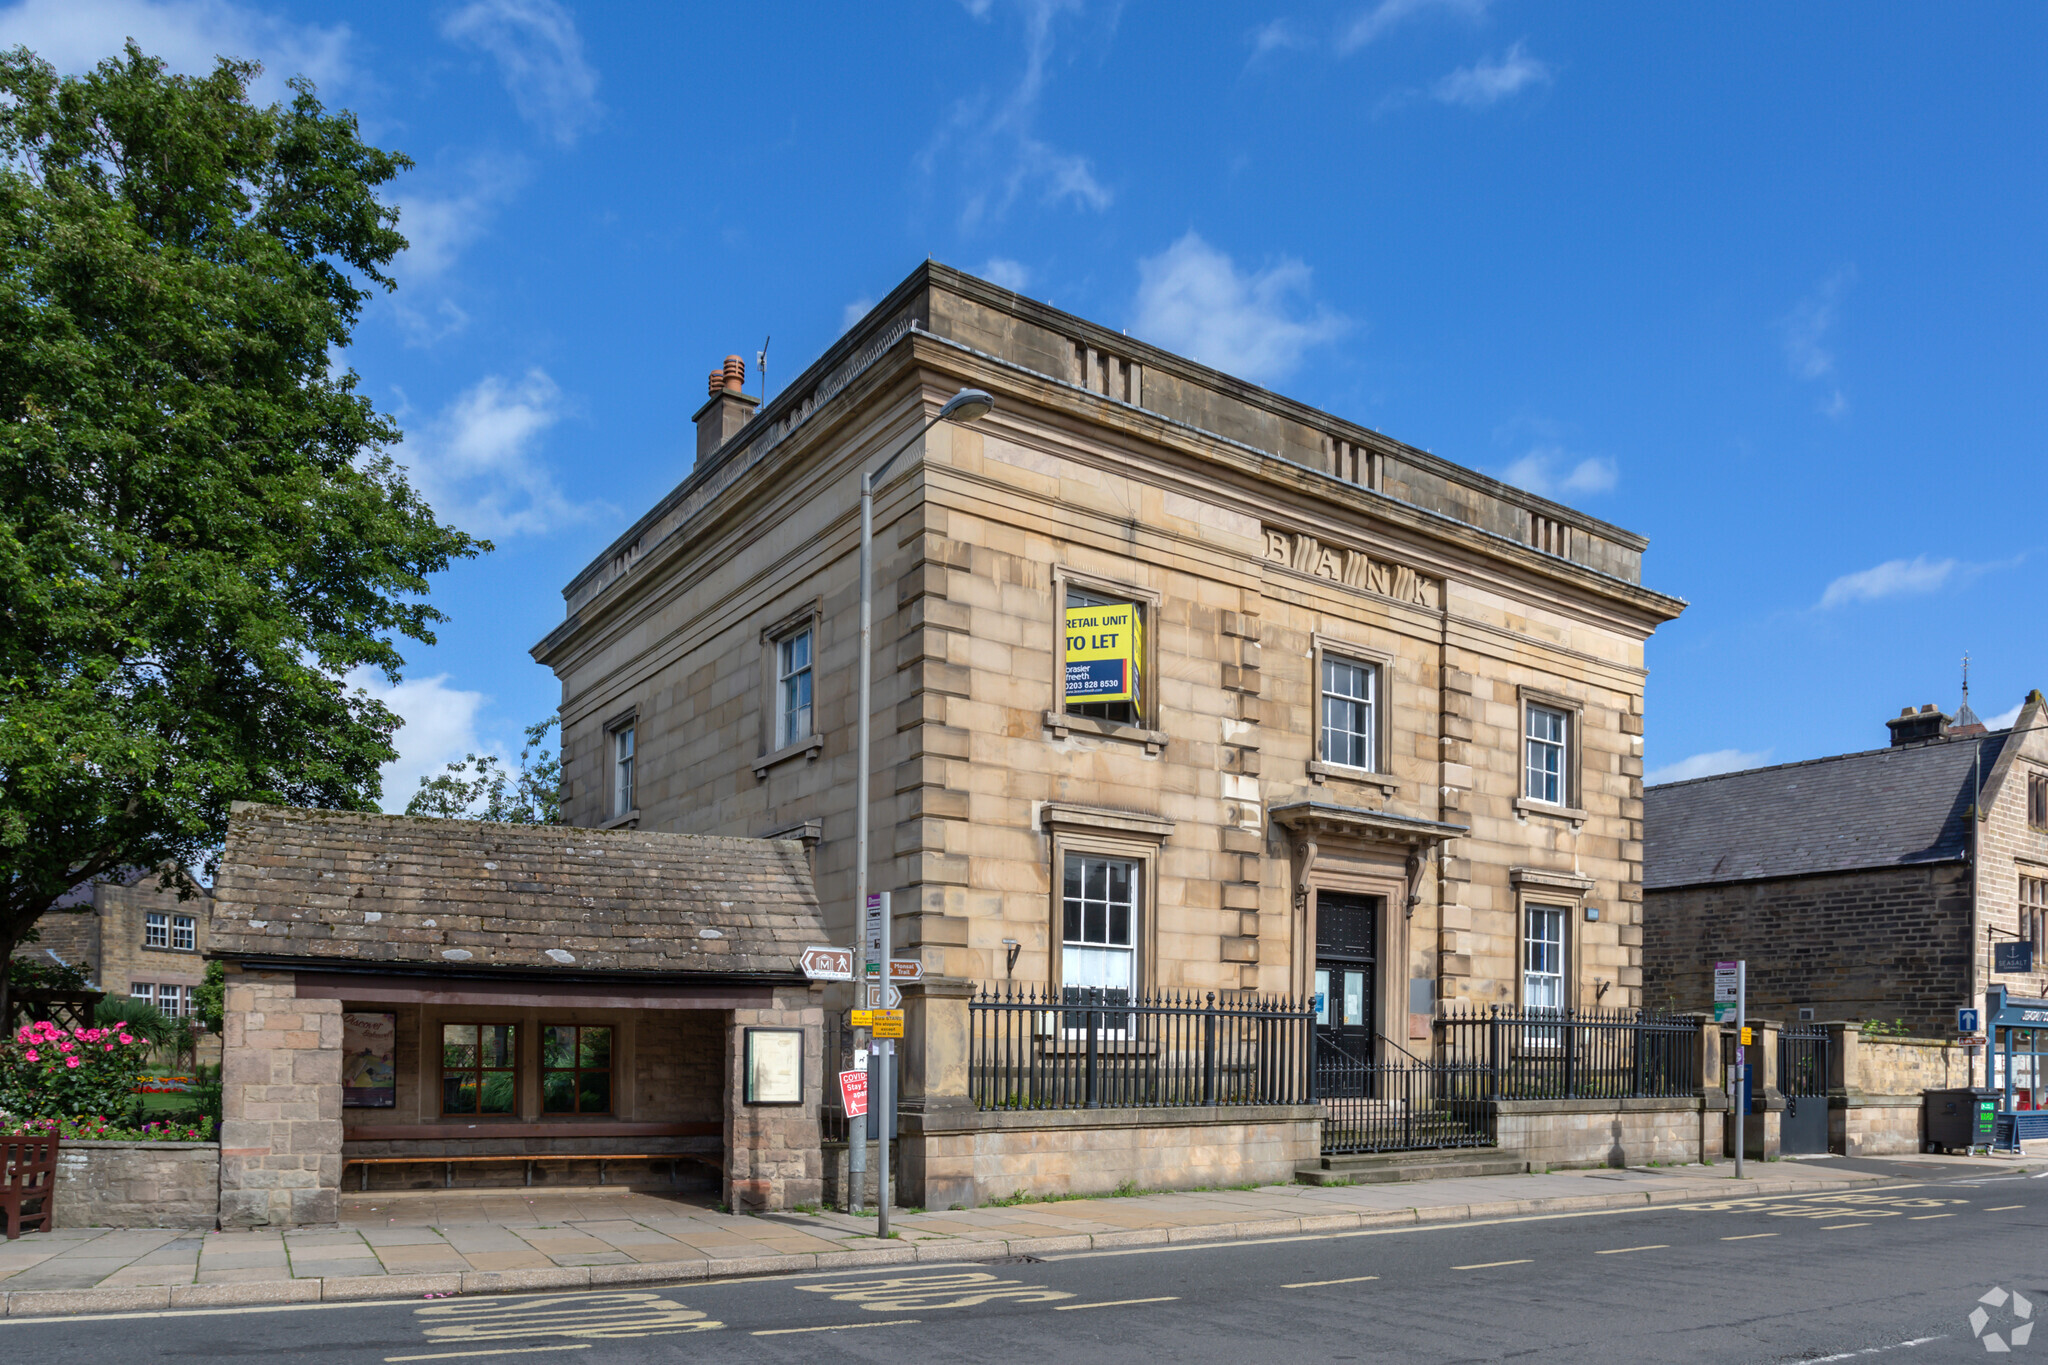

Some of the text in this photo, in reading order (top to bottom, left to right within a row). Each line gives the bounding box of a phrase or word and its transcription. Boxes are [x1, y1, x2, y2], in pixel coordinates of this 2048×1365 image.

[1265, 528, 1432, 608] BANK
[1066, 615, 1128, 628] RETAIL UNIT
[1066, 634, 1118, 651] TO LET
[843, 1072, 867, 1082] COVID-
[847, 1083, 862, 1092] Stay
[853, 1090, 867, 1099] apar
[793, 1272, 1078, 1312] BUS
[412, 1293, 728, 1344] STOP
